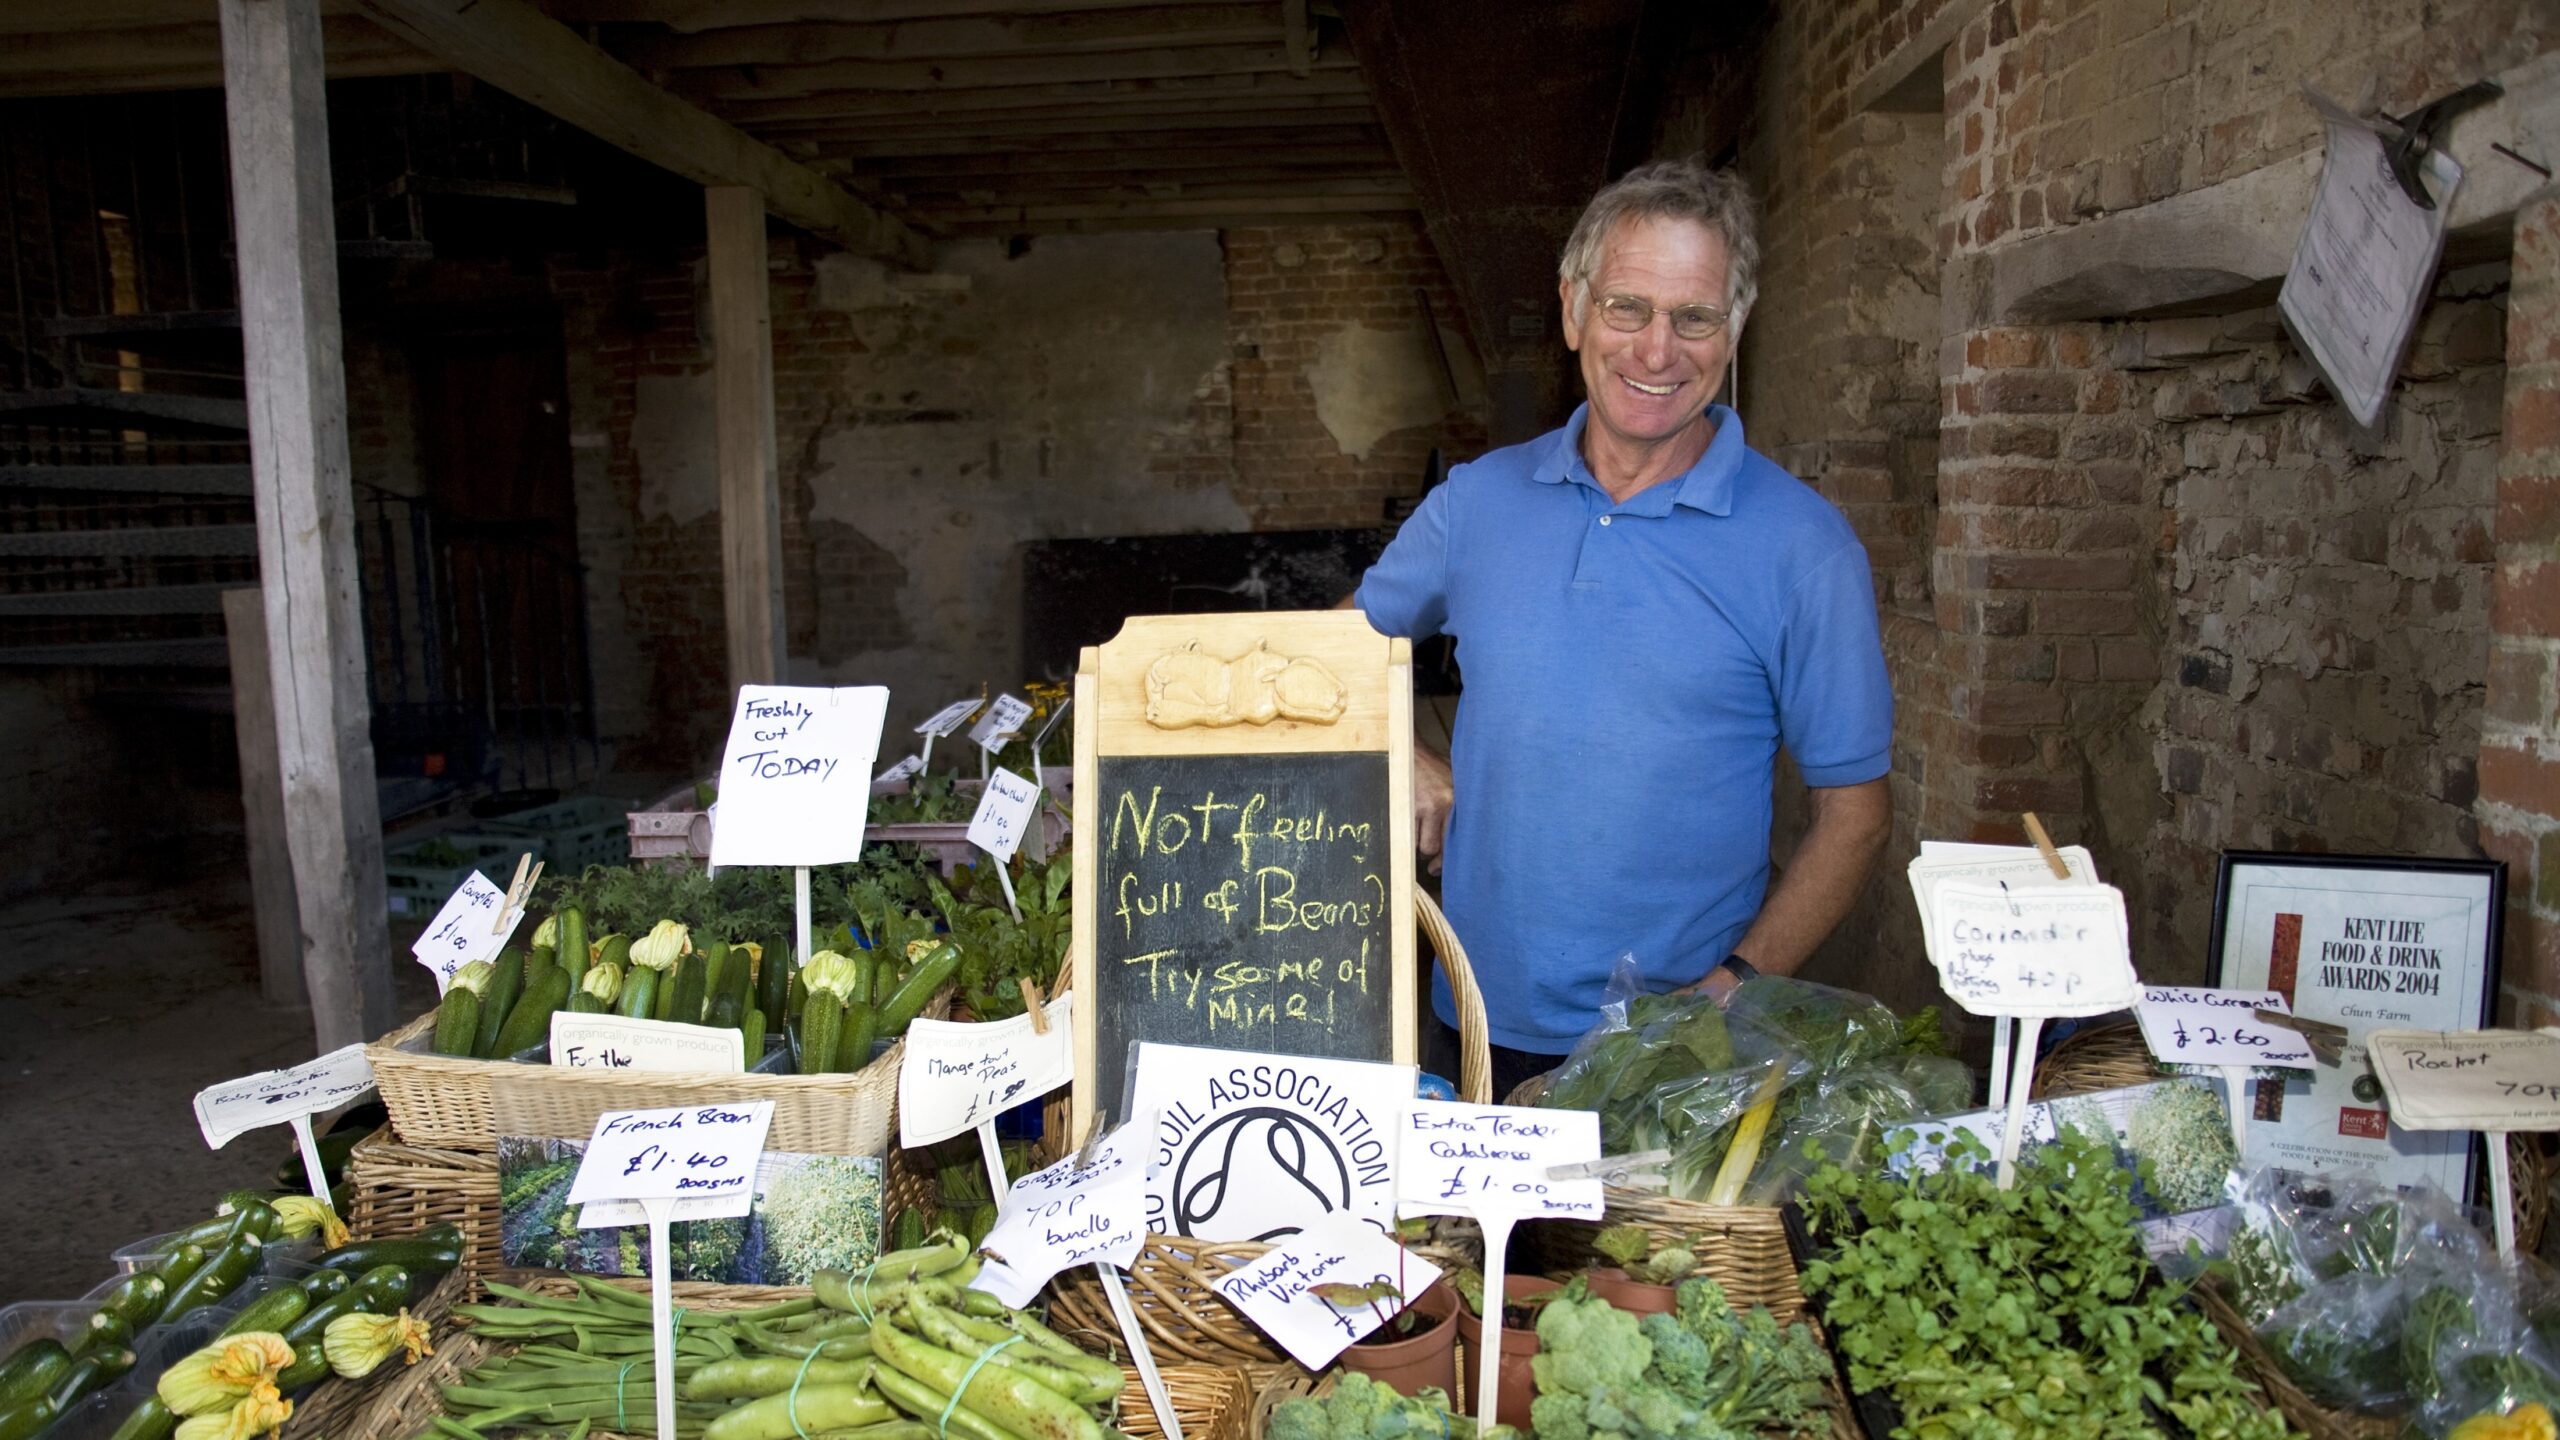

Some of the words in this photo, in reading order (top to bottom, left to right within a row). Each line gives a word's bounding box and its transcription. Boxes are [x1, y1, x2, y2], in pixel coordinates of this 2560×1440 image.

[745, 698, 813, 731] Freshly
[754, 727, 798, 742] cut
[737, 750, 839, 783] TODAY
[1232, 792, 1371, 872] feeling
[2028, 859, 2078, 872] proe
[1115, 872, 1183, 940] full
[1203, 879, 1240, 924] of
[2344, 917, 2386, 941] KENT
[2388, 920, 2425, 944] LIFE
[2321, 941, 2366, 964] FOOD
[2370, 945, 2383, 966] &
[2387, 946, 2442, 970] DRINK
[1124, 948, 1203, 1009] Try
[1209, 958, 1325, 994] some
[1337, 936, 1371, 995] of
[2316, 965, 2392, 992] AWARDS
[2395, 970, 2440, 996] 2004
[2376, 1008, 2411, 1021] Farm
[563, 1028, 629, 1045] organically
[632, 1033, 673, 1045] grown
[676, 1036, 729, 1054] produce
[928, 1058, 974, 1078] Mange
[976, 1061, 1017, 1084] Peas
[2402, 1050, 2491, 1071] Rocket
[601, 1112, 684, 1137] French
[1209, 1066, 1391, 1188] ASSOCIATION
[1412, 1112, 1476, 1132] Extra
[623, 1145, 728, 1176] £1.40
[1440, 1166, 1548, 1199] £1.00
[1223, 1252, 1300, 1302] Rhubarb
[1268, 1253, 1346, 1304] Victoria
